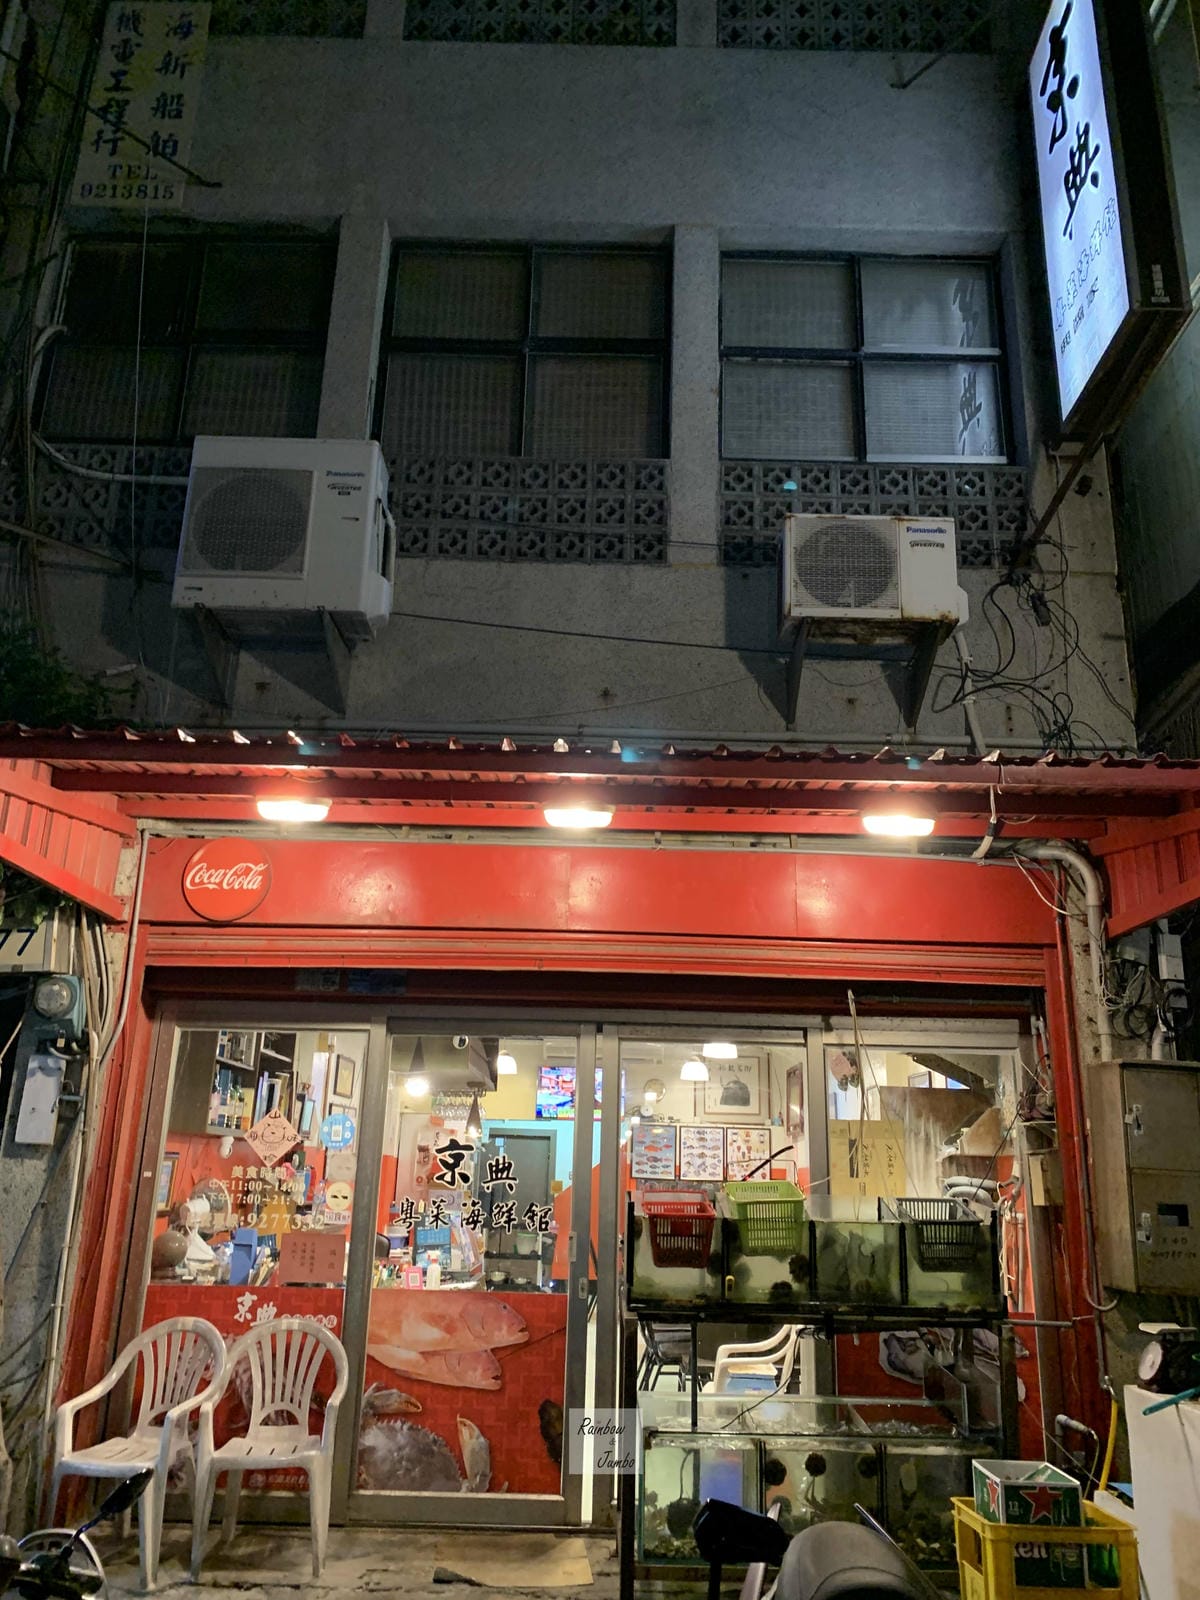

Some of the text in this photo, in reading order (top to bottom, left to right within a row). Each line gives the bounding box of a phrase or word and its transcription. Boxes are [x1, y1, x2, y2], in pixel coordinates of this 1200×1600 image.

[1039, 0, 1101, 241] 京典
[108, 164, 159, 180] TEL
[906, 526, 947, 534] Panasonic
[186, 863, 268, 890] Coca-Cola
[434, 1138, 518, 1194] 京 典
[233, 1290, 278, 1327] 京典
